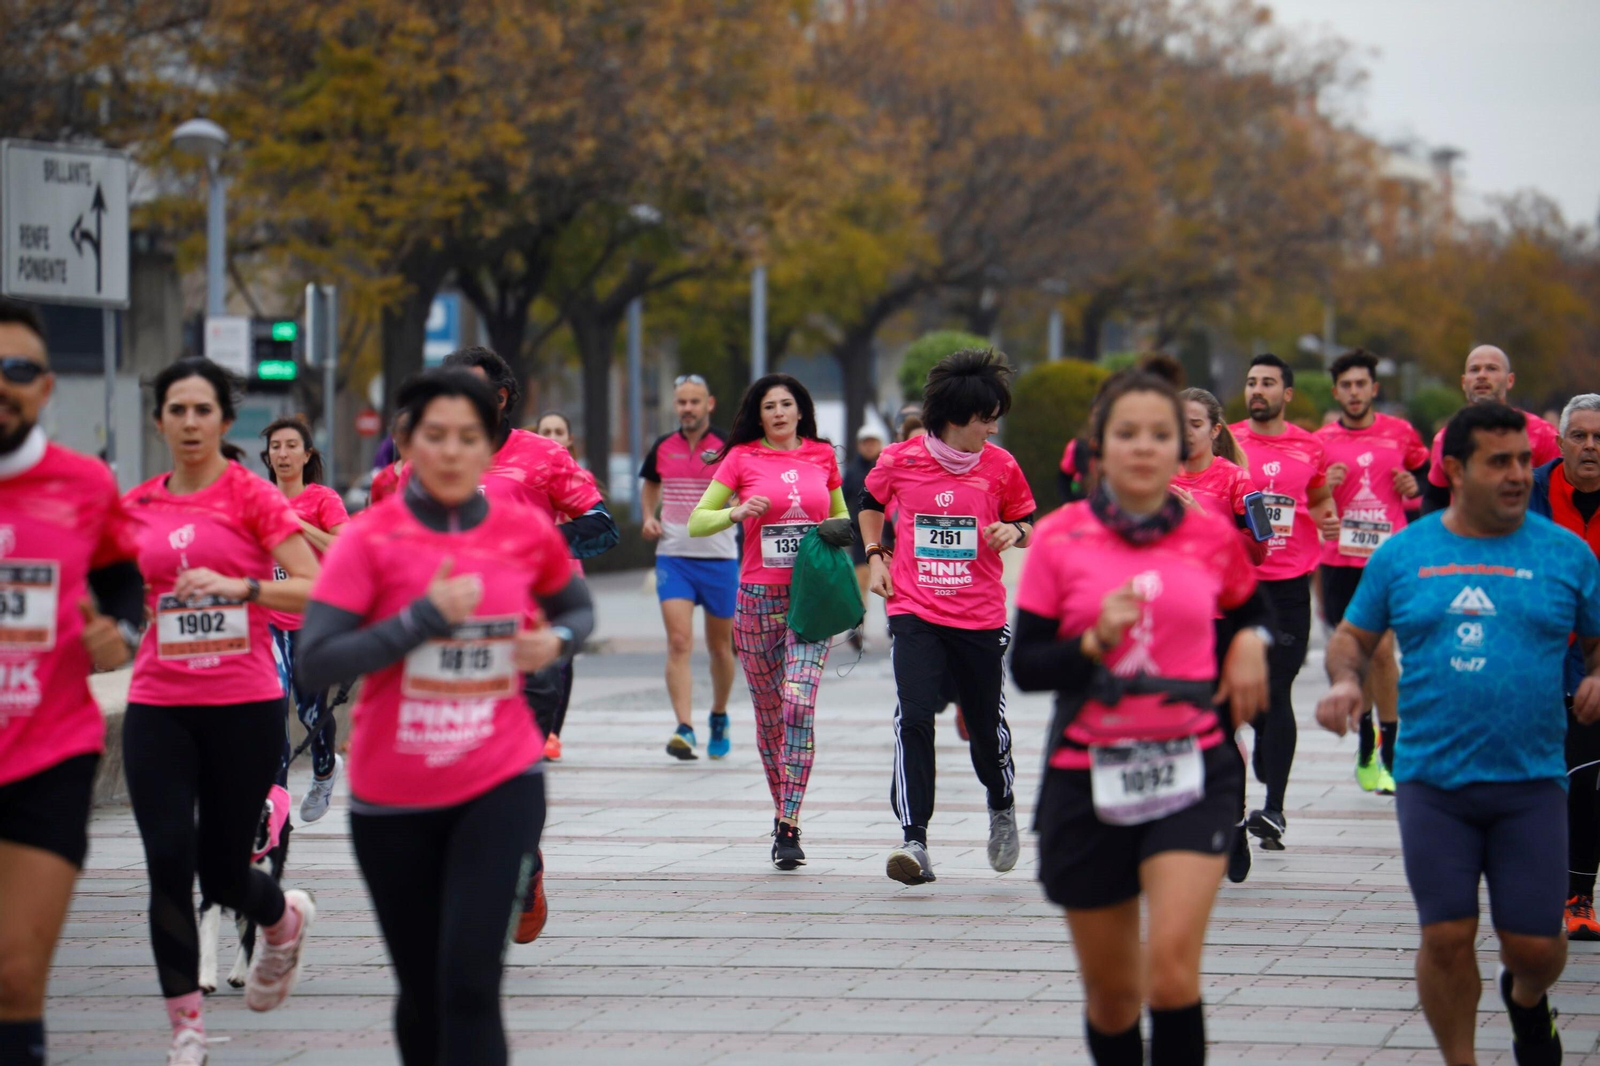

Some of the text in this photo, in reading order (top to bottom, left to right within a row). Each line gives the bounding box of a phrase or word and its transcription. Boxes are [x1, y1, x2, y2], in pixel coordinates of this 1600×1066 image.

[43, 159, 92, 186] BRILLANTE
[19, 225, 49, 250] RENFE
[18, 256, 67, 283] PONENTE
[774, 538, 803, 553] 133
[930, 529, 961, 545] 2151
[1350, 530, 1380, 546] 2070
[917, 561, 970, 576] PINK
[918, 574, 972, 585] RUNNING
[178, 612, 225, 635] 1902
[400, 698, 497, 727] PINK
[1120, 763, 1175, 793] 1092
